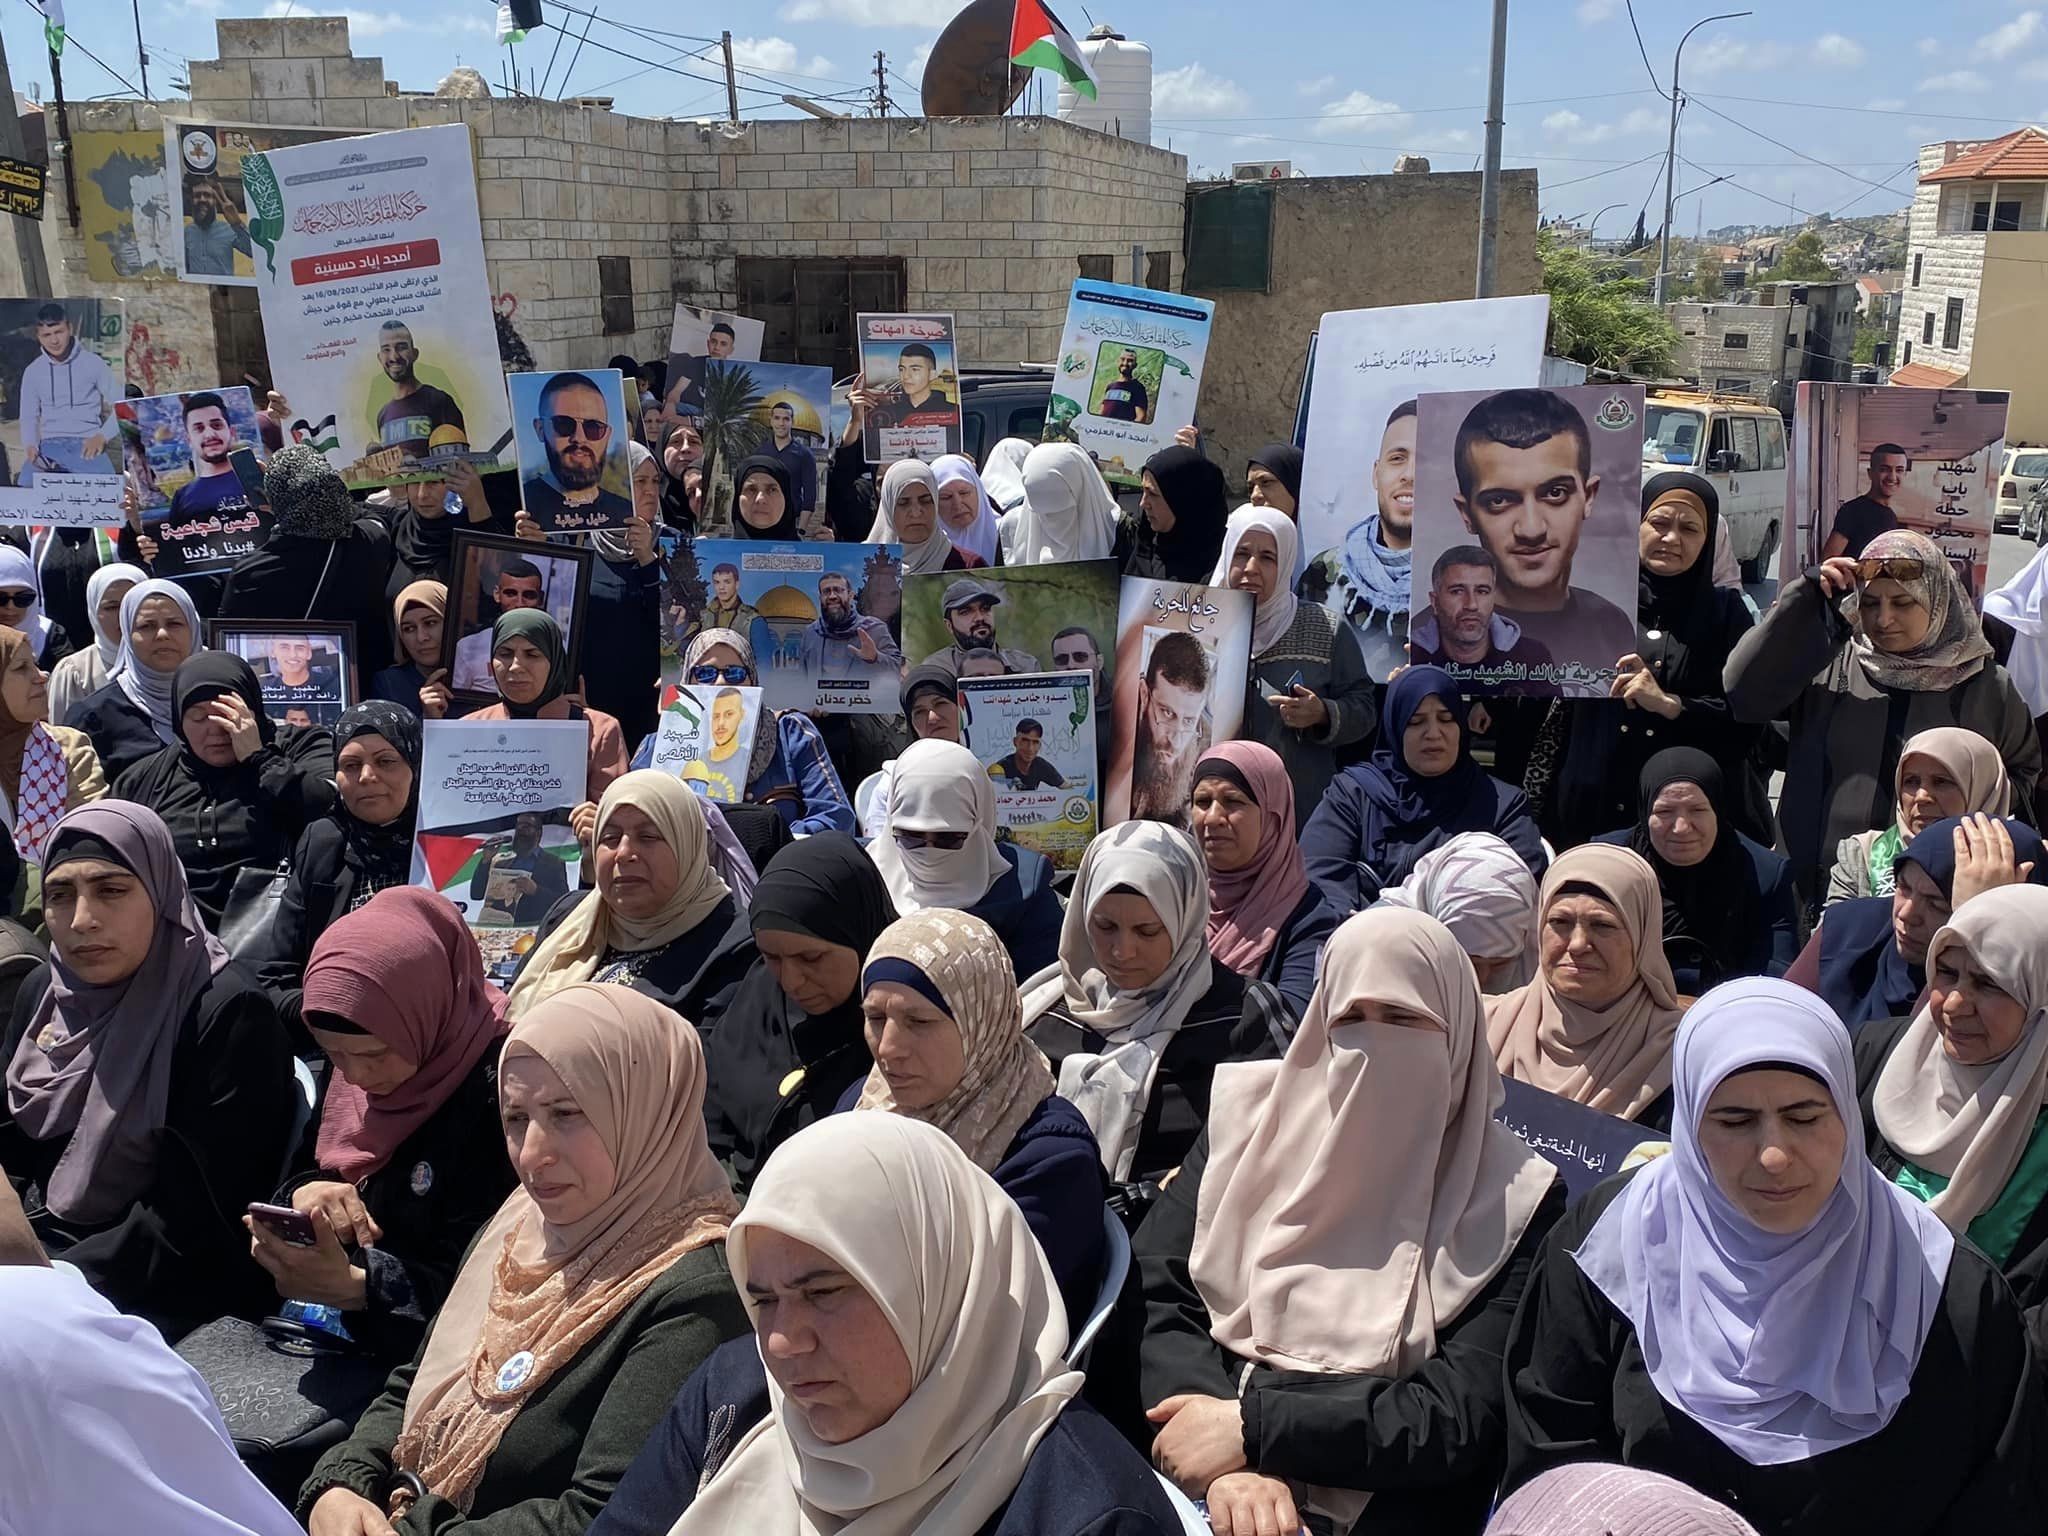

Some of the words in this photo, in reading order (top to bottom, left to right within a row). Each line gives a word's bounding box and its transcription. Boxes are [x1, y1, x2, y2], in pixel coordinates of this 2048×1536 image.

[360, 254, 380, 270] إياد
[383, 246, 411, 265] أمجد
[314, 260, 357, 277] حسينية
[910, 324, 944, 338] صرخة
[1937, 461, 1977, 476] شهيد
[1942, 481, 1968, 498] باب
[1935, 501, 1969, 516] حطة
[70, 510, 83, 525] في
[223, 511, 260, 534] قيس
[160, 515, 222, 540] شجاعية
[1924, 525, 1975, 539] محمود
[1943, 545, 1977, 561] السنا
[1153, 588, 1190, 623] للحرية
[1189, 591, 1220, 632] جائع
[1445, 661, 1473, 680] سنا
[1474, 660, 1528, 685] الشهيد
[1529, 661, 1568, 685] لوالد
[815, 693, 845, 706] عدنان
[848, 693, 872, 707] خضر
[663, 728, 700, 744] شهيد
[1551, 1138, 1583, 1161] الجنة
[1583, 1145, 1607, 1173] إنها
